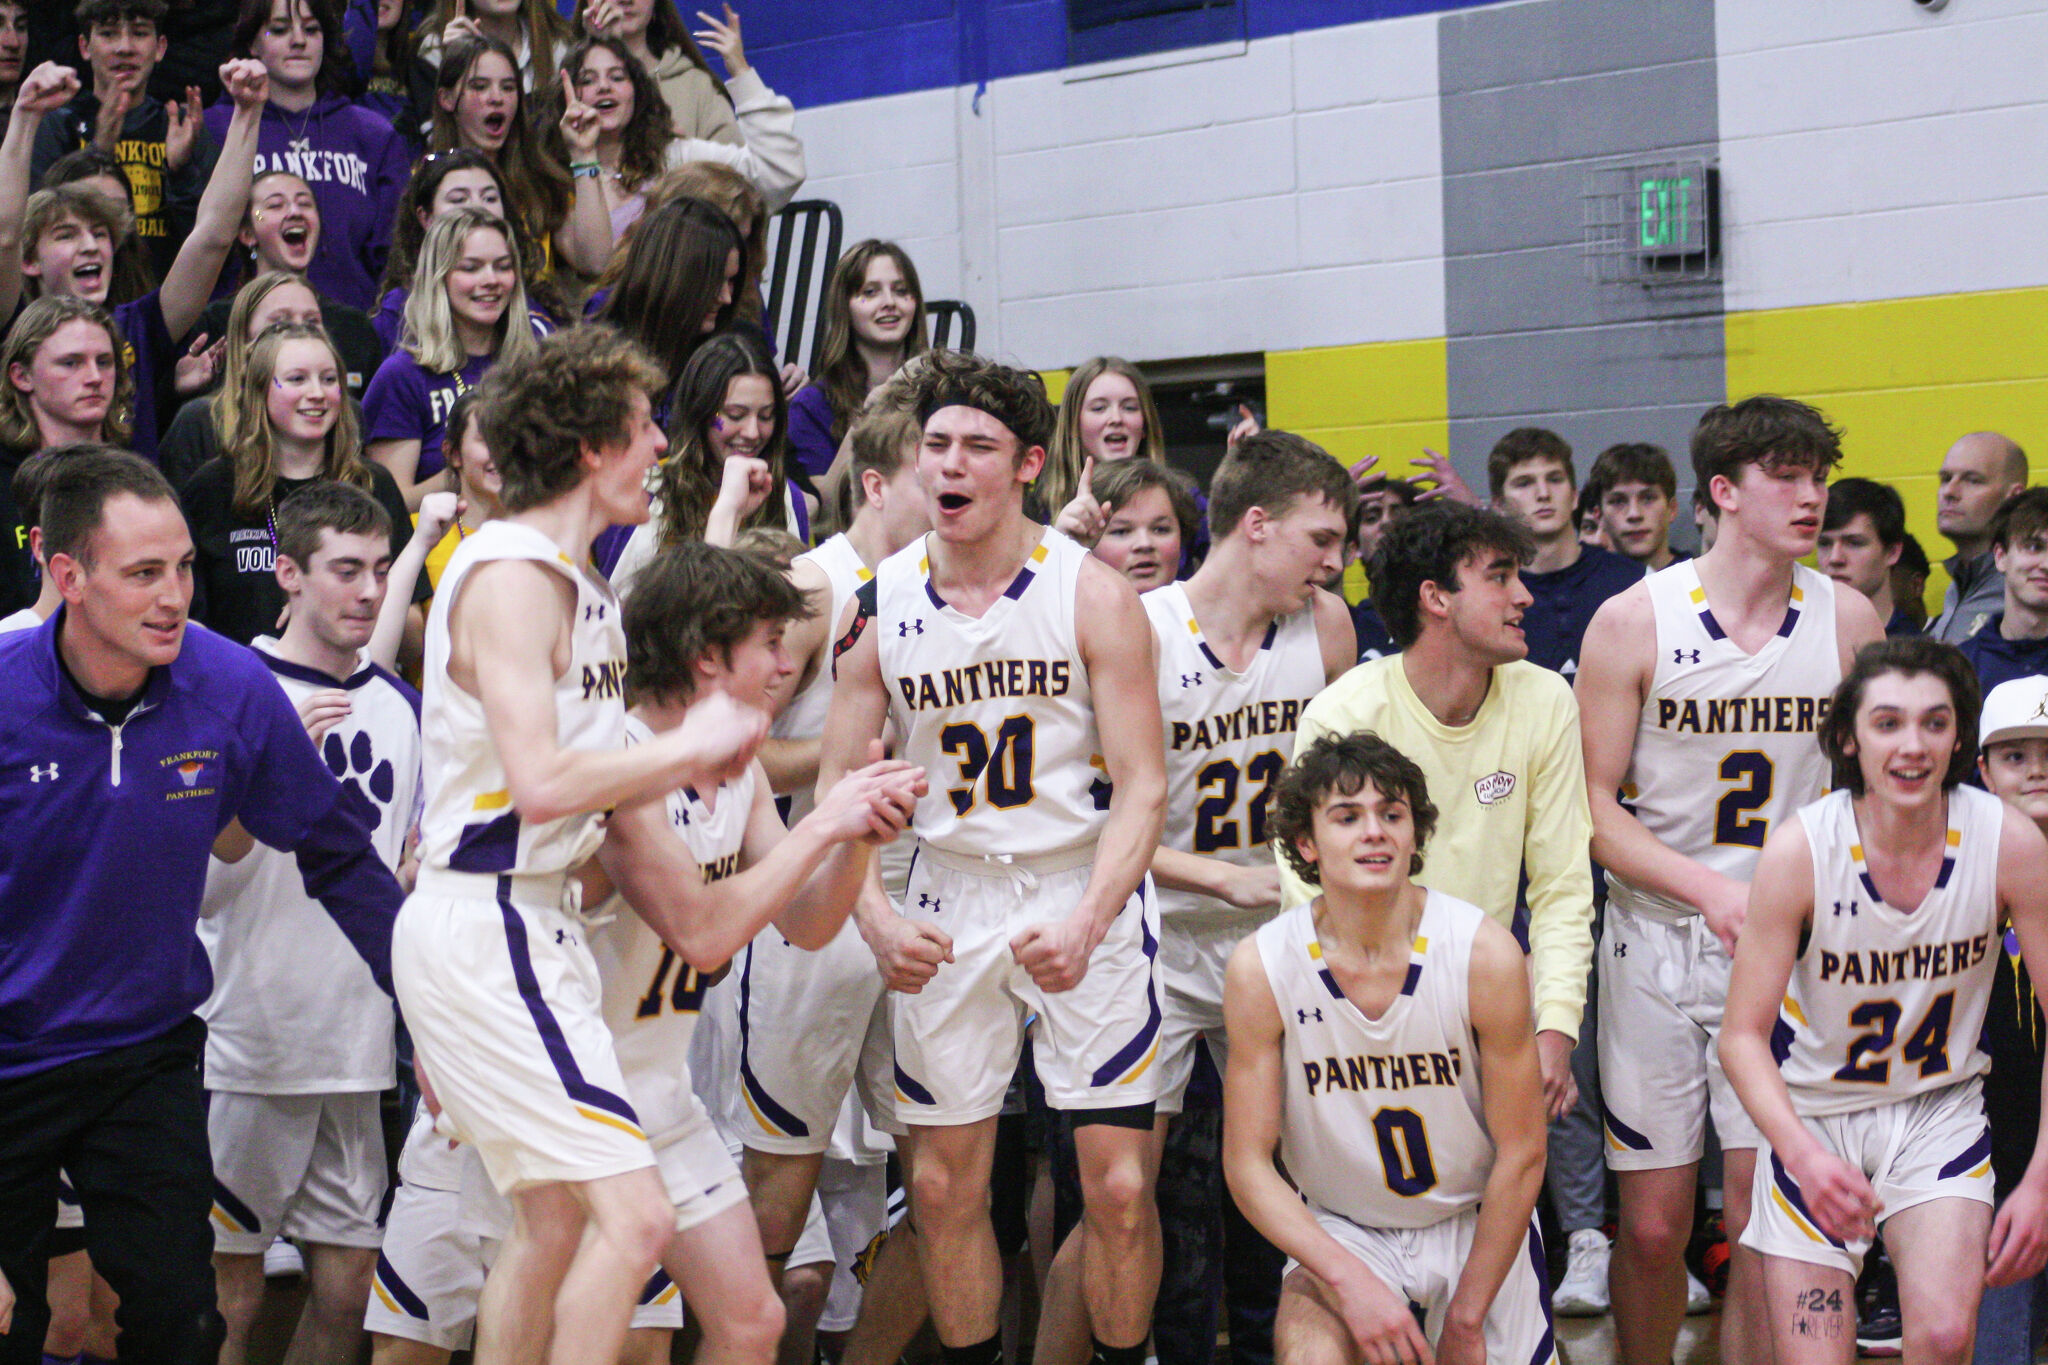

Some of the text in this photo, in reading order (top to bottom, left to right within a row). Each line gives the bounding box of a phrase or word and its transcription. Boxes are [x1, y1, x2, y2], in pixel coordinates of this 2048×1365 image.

[253, 150, 368, 197] RANKFORT
[1641, 176, 1691, 247] EXIT
[237, 546, 277, 573] VOL
[898, 660, 1071, 711] PANTHERS
[160, 750, 219, 767] FRANKFORT
[939, 712, 1036, 819] 30
[166, 788, 215, 801] PANTHERS
[1193, 748, 1287, 854] 22
[1712, 749, 1775, 850] 2
[1820, 932, 1988, 986] PANTHERS
[1831, 987, 1956, 1088] 24
[1371, 1105, 1439, 1197] 0
[1797, 1288, 1843, 1312] #24
